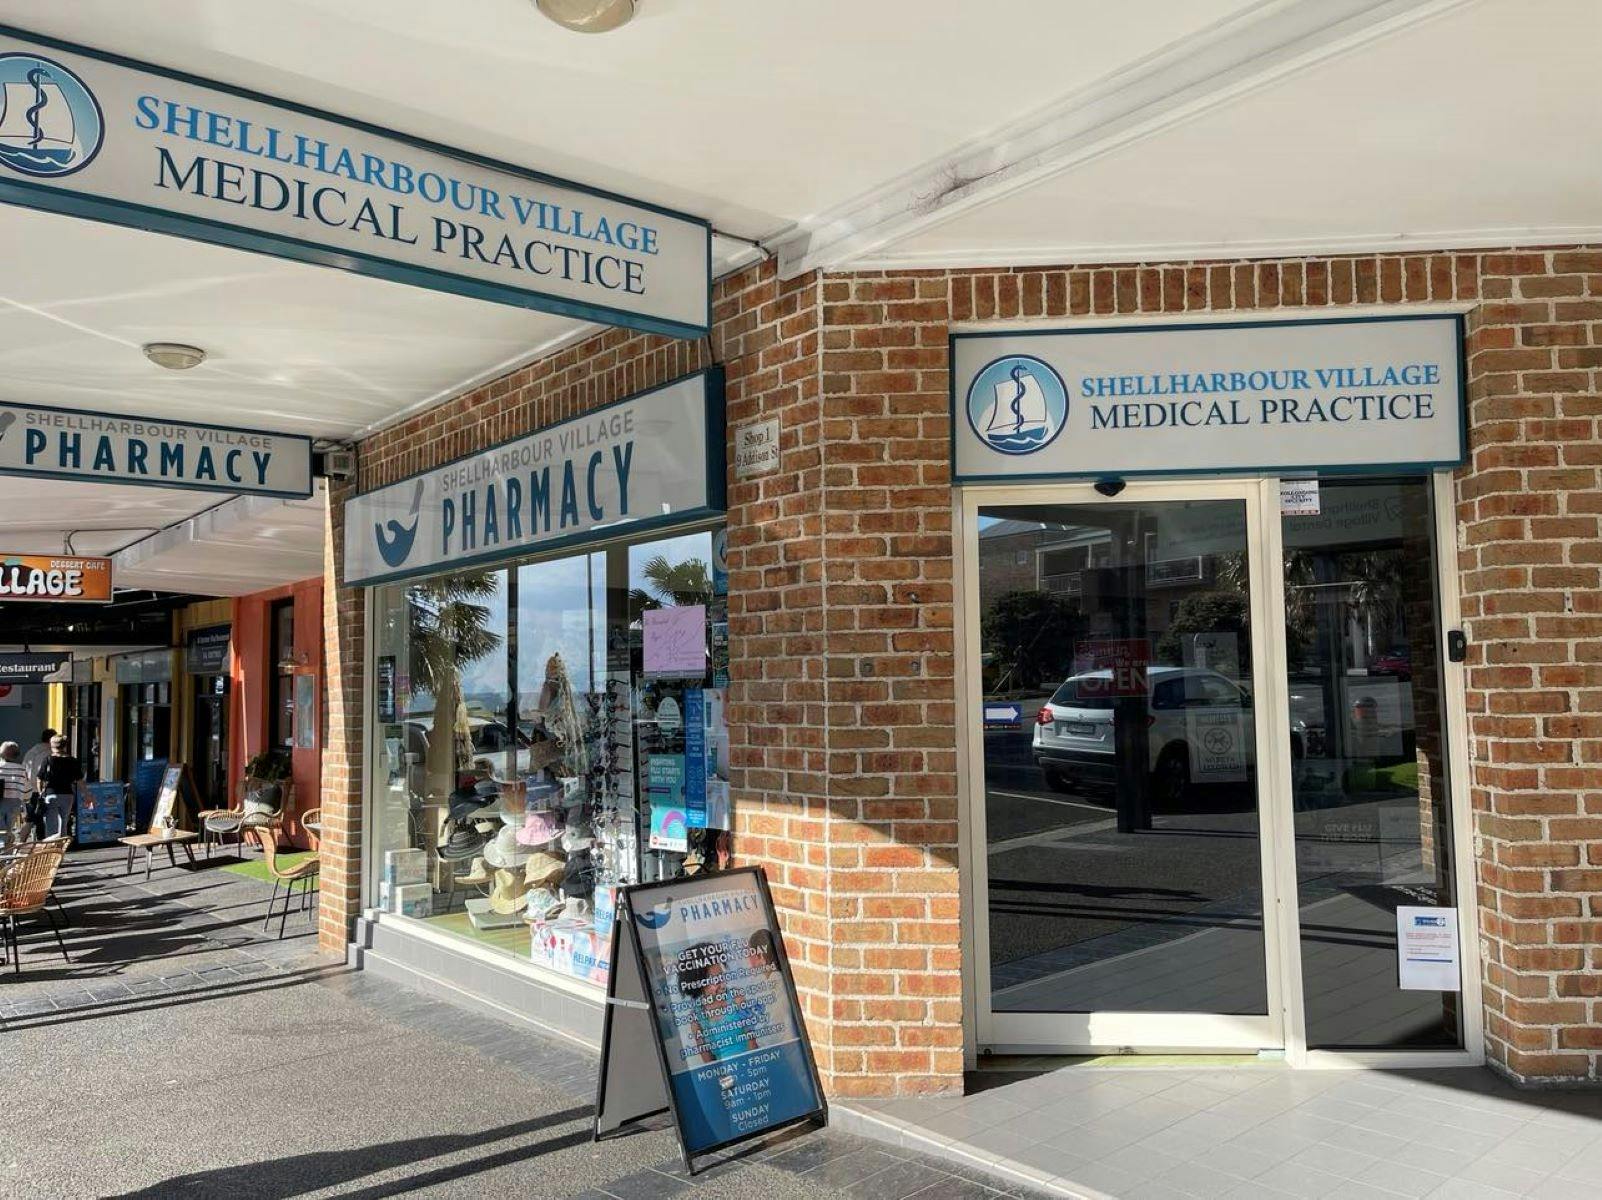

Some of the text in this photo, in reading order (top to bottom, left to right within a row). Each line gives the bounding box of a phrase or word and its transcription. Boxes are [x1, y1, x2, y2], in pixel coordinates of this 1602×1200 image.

[136, 95, 659, 255] SHELLHARBOUR VILLAGE
[153, 147, 646, 295] MEDICAL PRACTICE
[1081, 364, 1440, 397] SHELLHARBOUR VILLAGE
[1091, 394, 1435, 430] MEDICAL PRACTICE
[26, 412, 272, 449] SHELLHARBOUR VILLAGE
[744, 431, 763, 446] Shop
[26, 428, 271, 484] PHARMACY
[443, 410, 634, 492] SHELLHARBOUR VILLAGE
[443, 441, 633, 555] PHARMACY
[86, 561, 105, 570] CAFE
[680, 894, 757, 922] PHARMACY
[663, 944, 769, 975] VACCINATION TODAY
[679, 948, 698, 961] GET
[699, 943, 729, 957] YOUR
[680, 972, 737, 991] Prescription
[671, 994, 713, 1011] Provided
[715, 991, 728, 1001] on
[730, 986, 745, 997] the
[675, 1012, 699, 1026] book
[700, 1002, 738, 1019] through
[741, 999, 756, 1009] our
[696, 1016, 757, 1039] Administered
[680, 1037, 733, 1059] pharmacist
[698, 1062, 739, 1081] MONDAY
[749, 1051, 781, 1066] FRIDAY
[747, 1066, 767, 1078] 5pm
[721, 1078, 770, 1100] SATURDAY
[731, 1104, 770, 1122] SUNDAY
[737, 1115, 769, 1131] Closed
